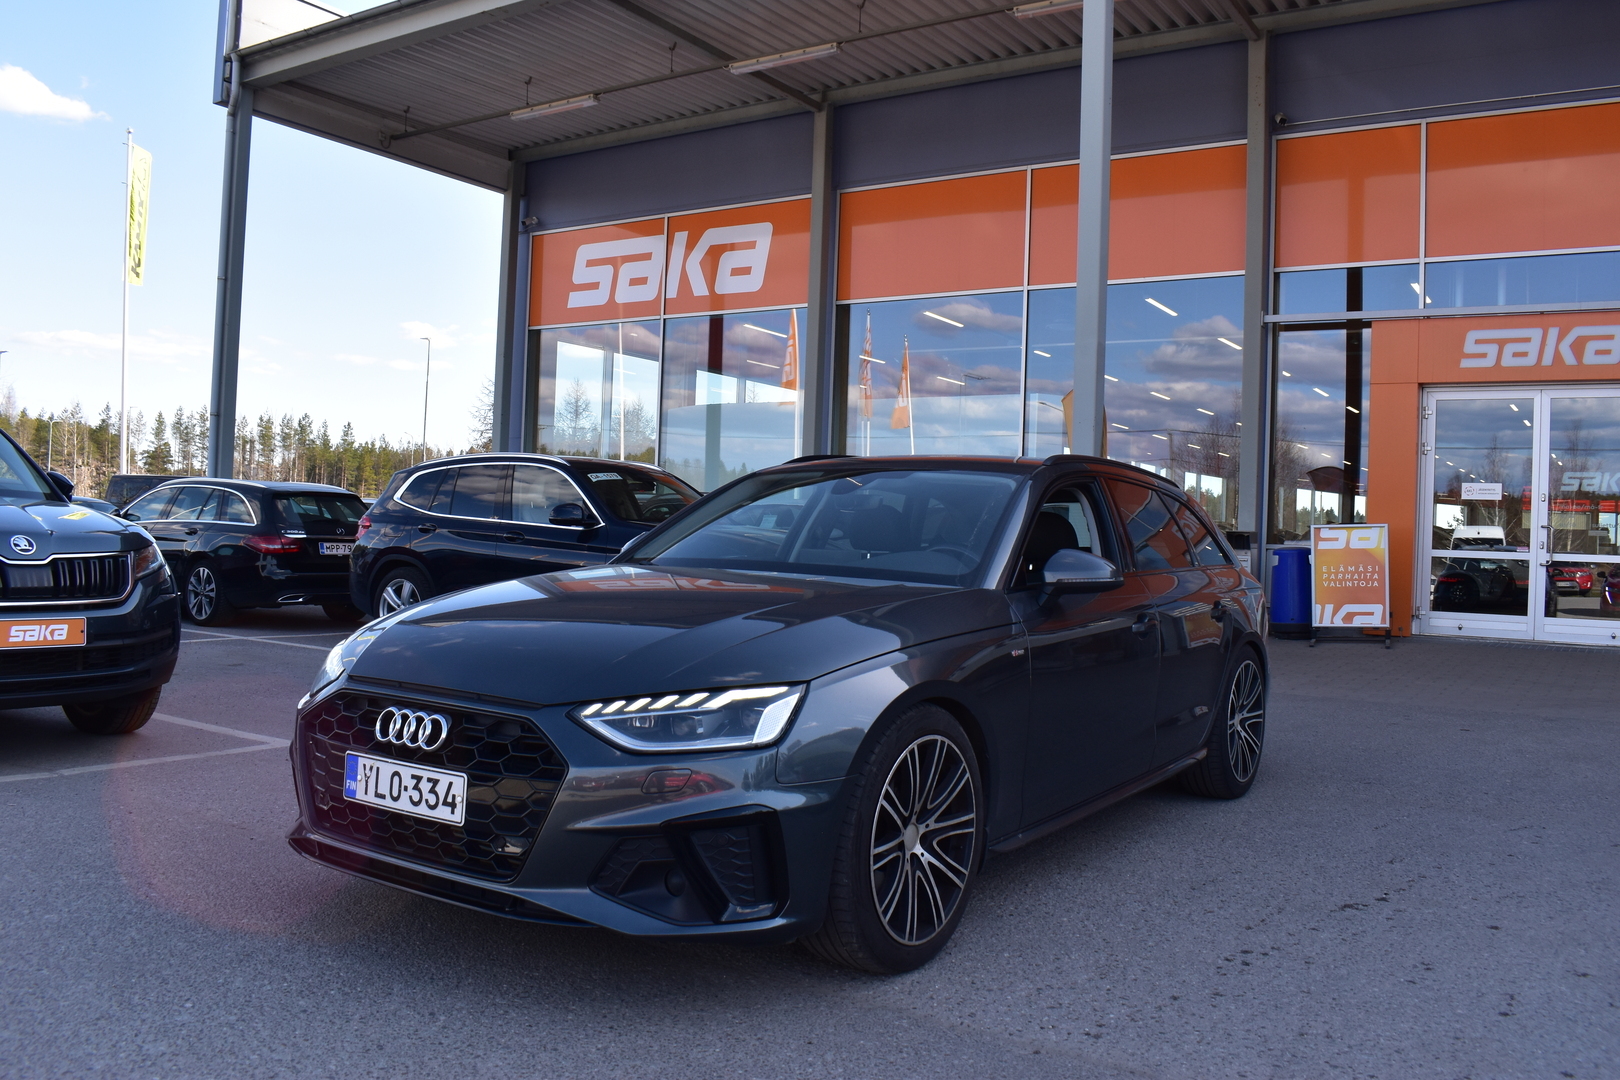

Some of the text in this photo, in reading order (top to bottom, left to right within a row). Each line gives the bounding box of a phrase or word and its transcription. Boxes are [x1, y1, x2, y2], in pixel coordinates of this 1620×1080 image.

[325, 544, 353, 553] MPP-79
[1322, 564, 1379, 572] ELÄMÄSI
[346, 780, 357, 791] FIN
[362, 763, 457, 815] YLO-334
